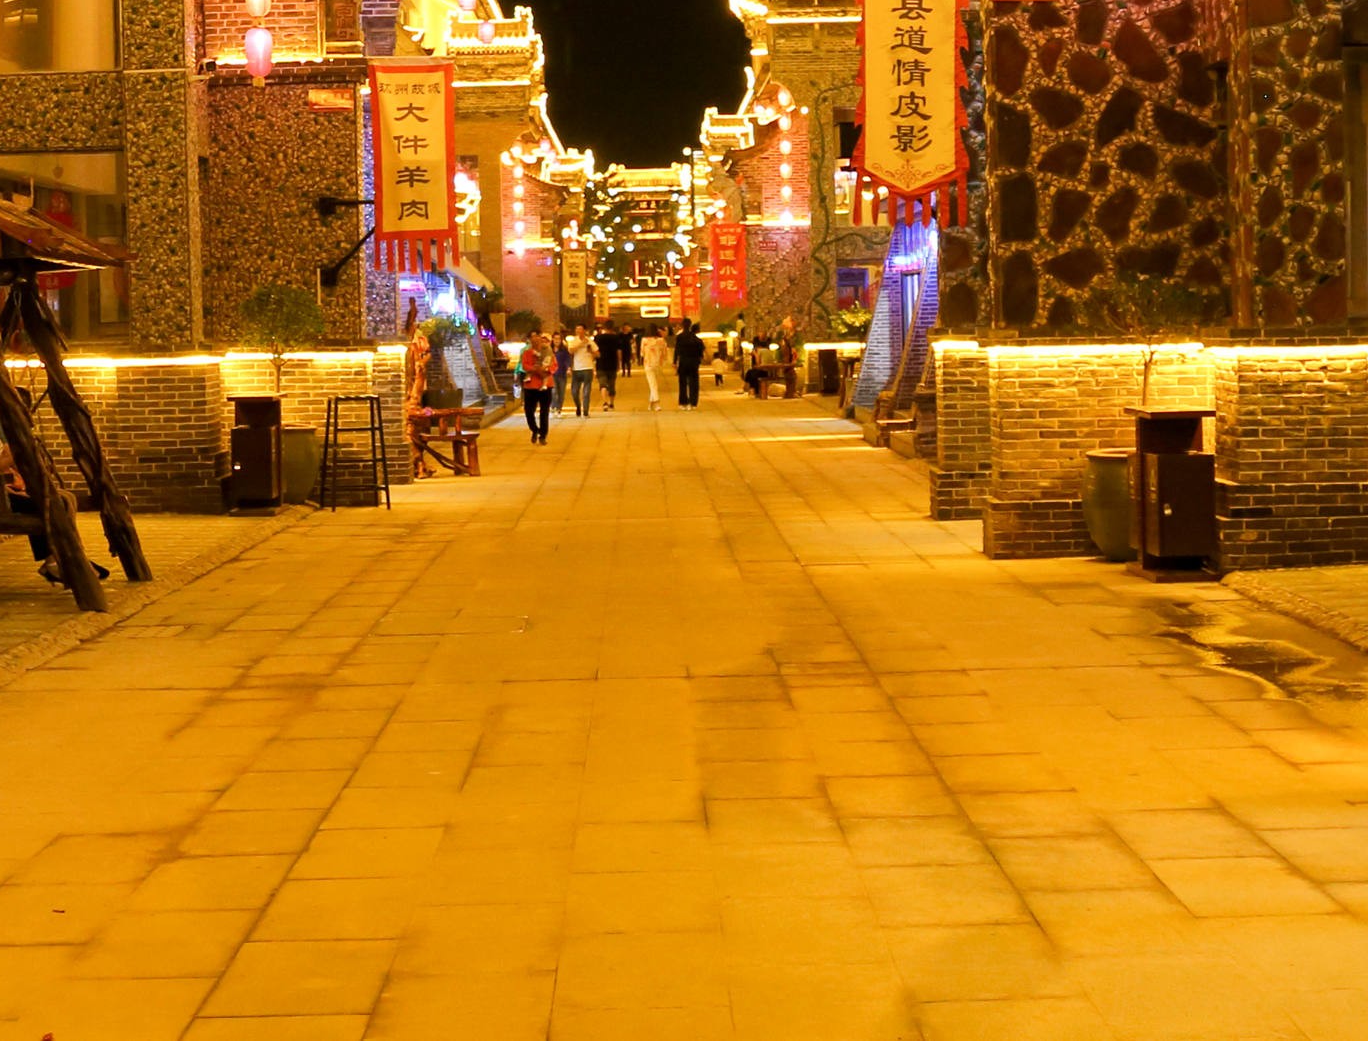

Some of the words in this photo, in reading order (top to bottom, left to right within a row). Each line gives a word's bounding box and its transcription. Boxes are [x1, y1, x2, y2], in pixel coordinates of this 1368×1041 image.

[393, 103, 430, 221] 大件羊肉
[719, 235, 738, 291] 非遗小吃
